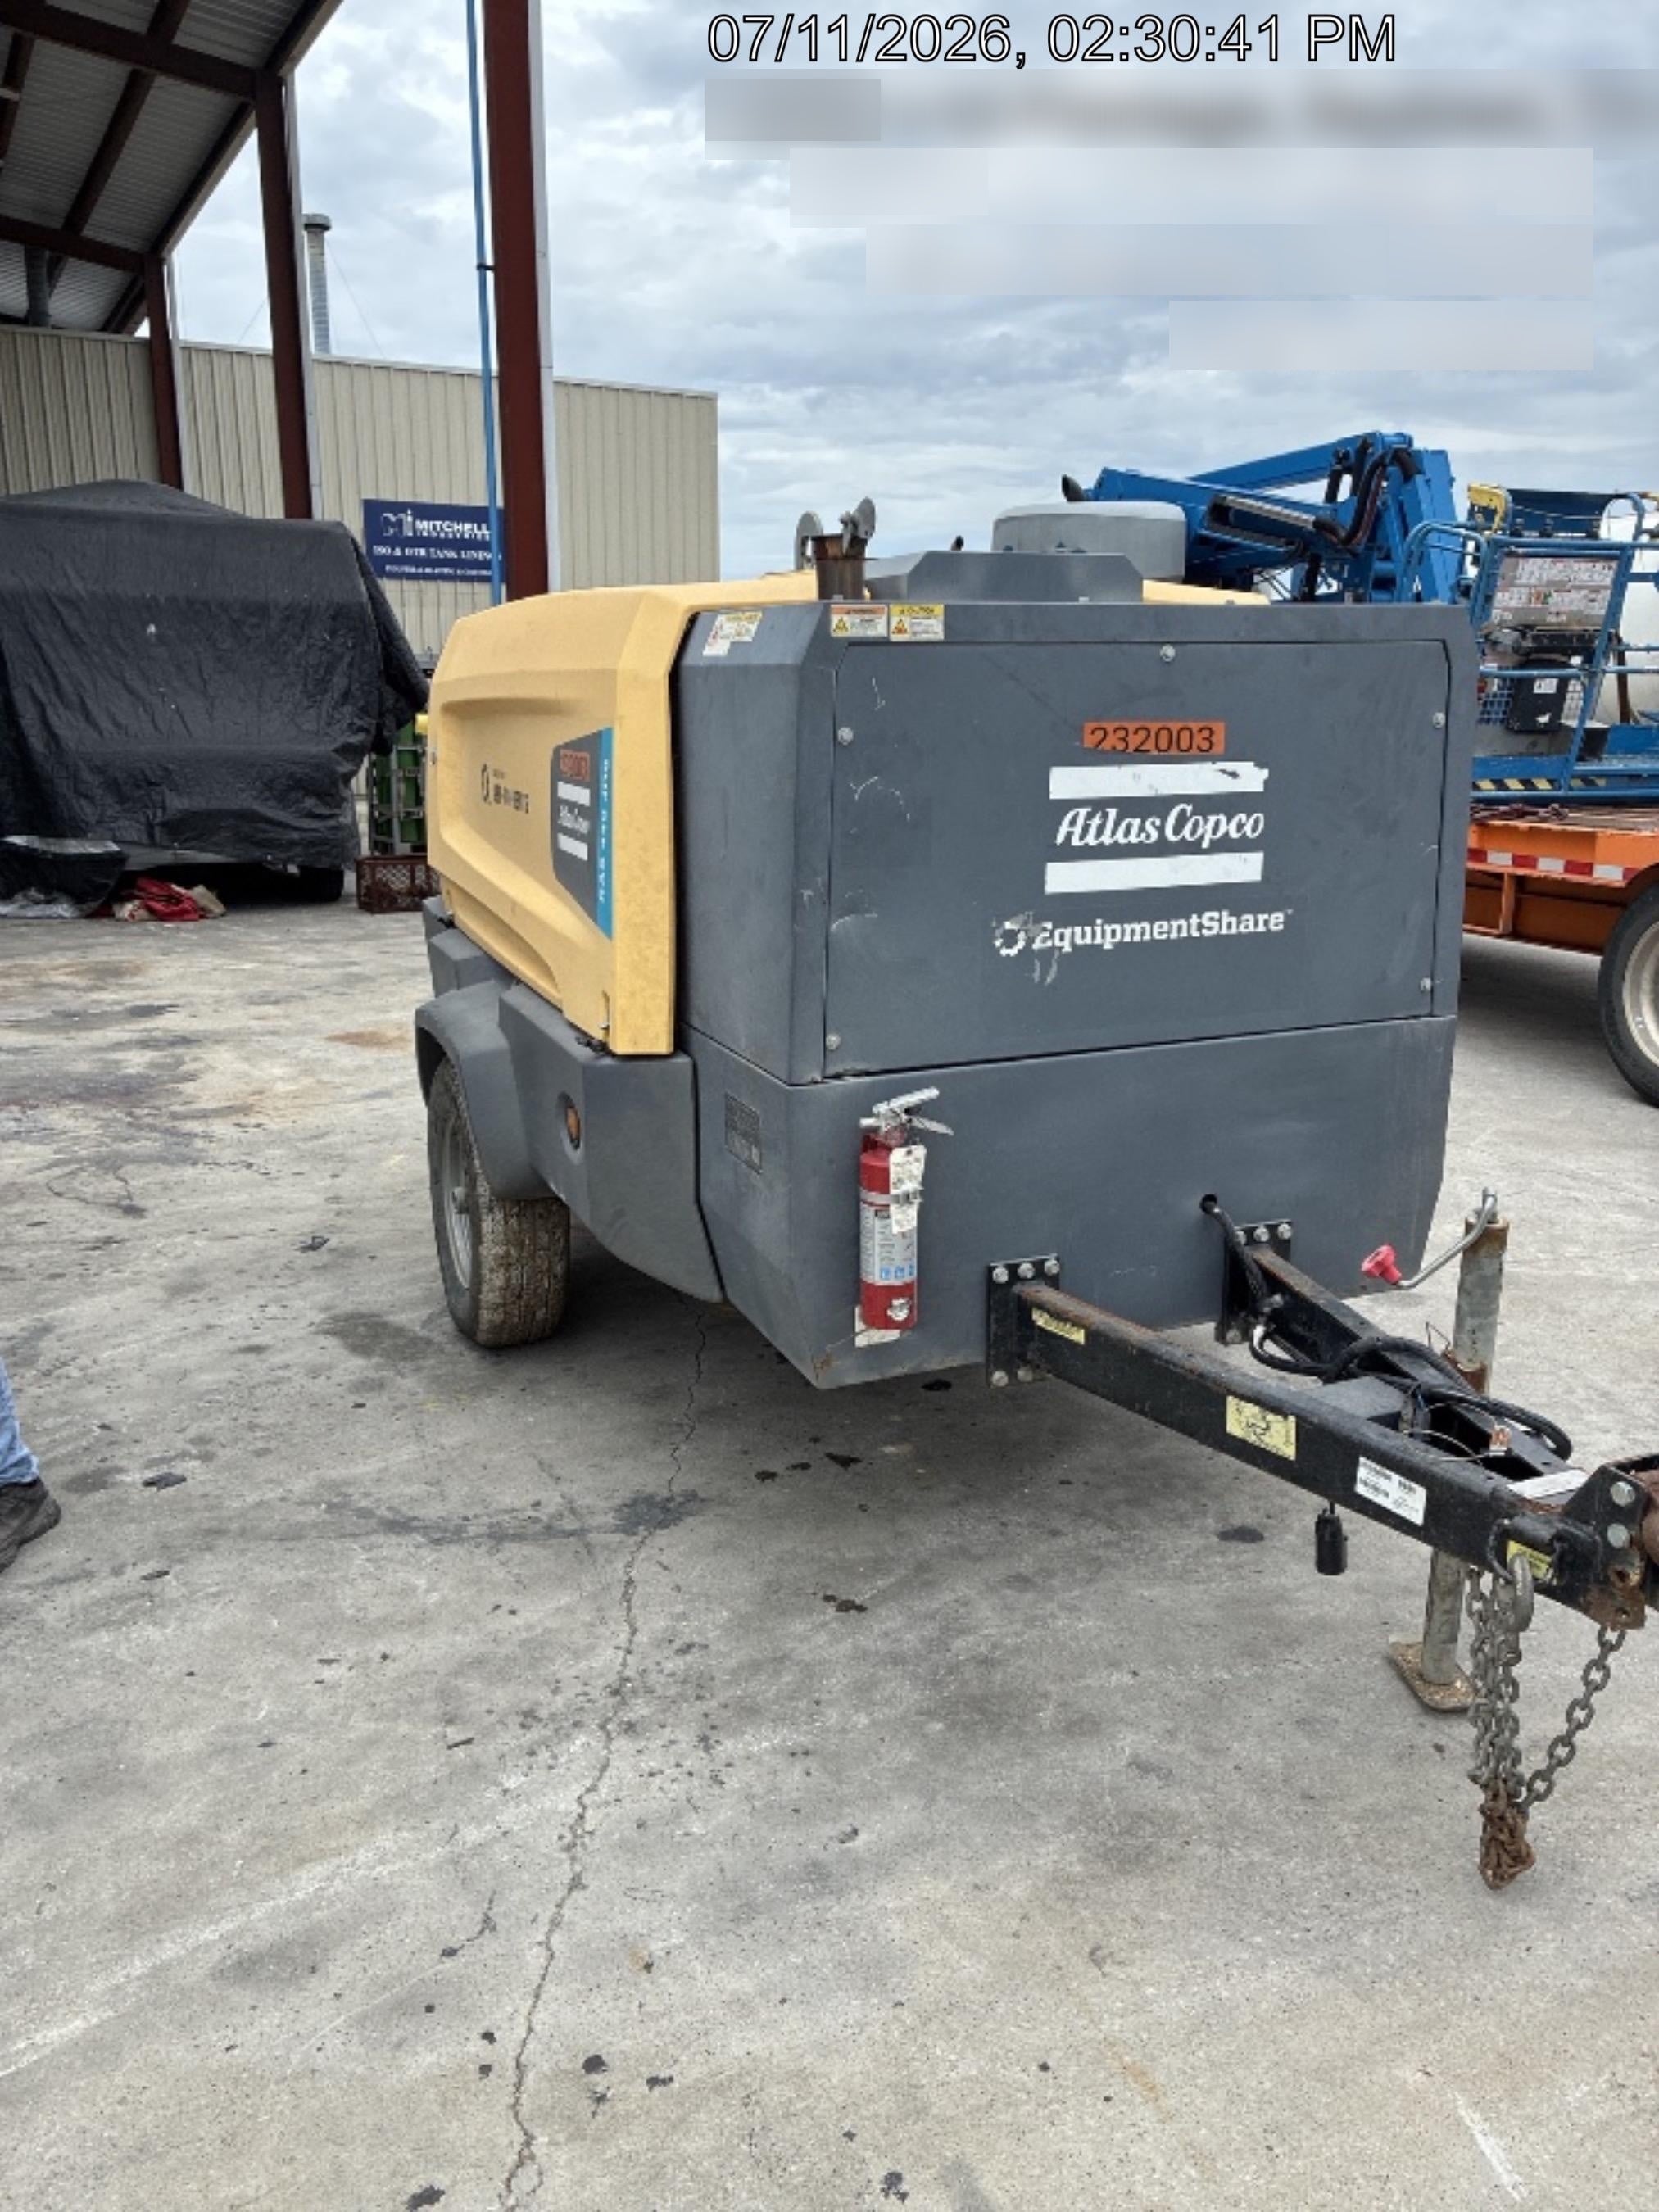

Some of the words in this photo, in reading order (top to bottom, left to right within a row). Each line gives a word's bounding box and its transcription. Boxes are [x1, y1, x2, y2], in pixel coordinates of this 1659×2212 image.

[415, 519, 491, 535] MITCHELL
[1090, 726, 1217, 753] 232003
[1055, 806, 1162, 847] Atlas
[1164, 803, 1265, 850] Copco
[1031, 909, 1285, 953] EquipmentShare
